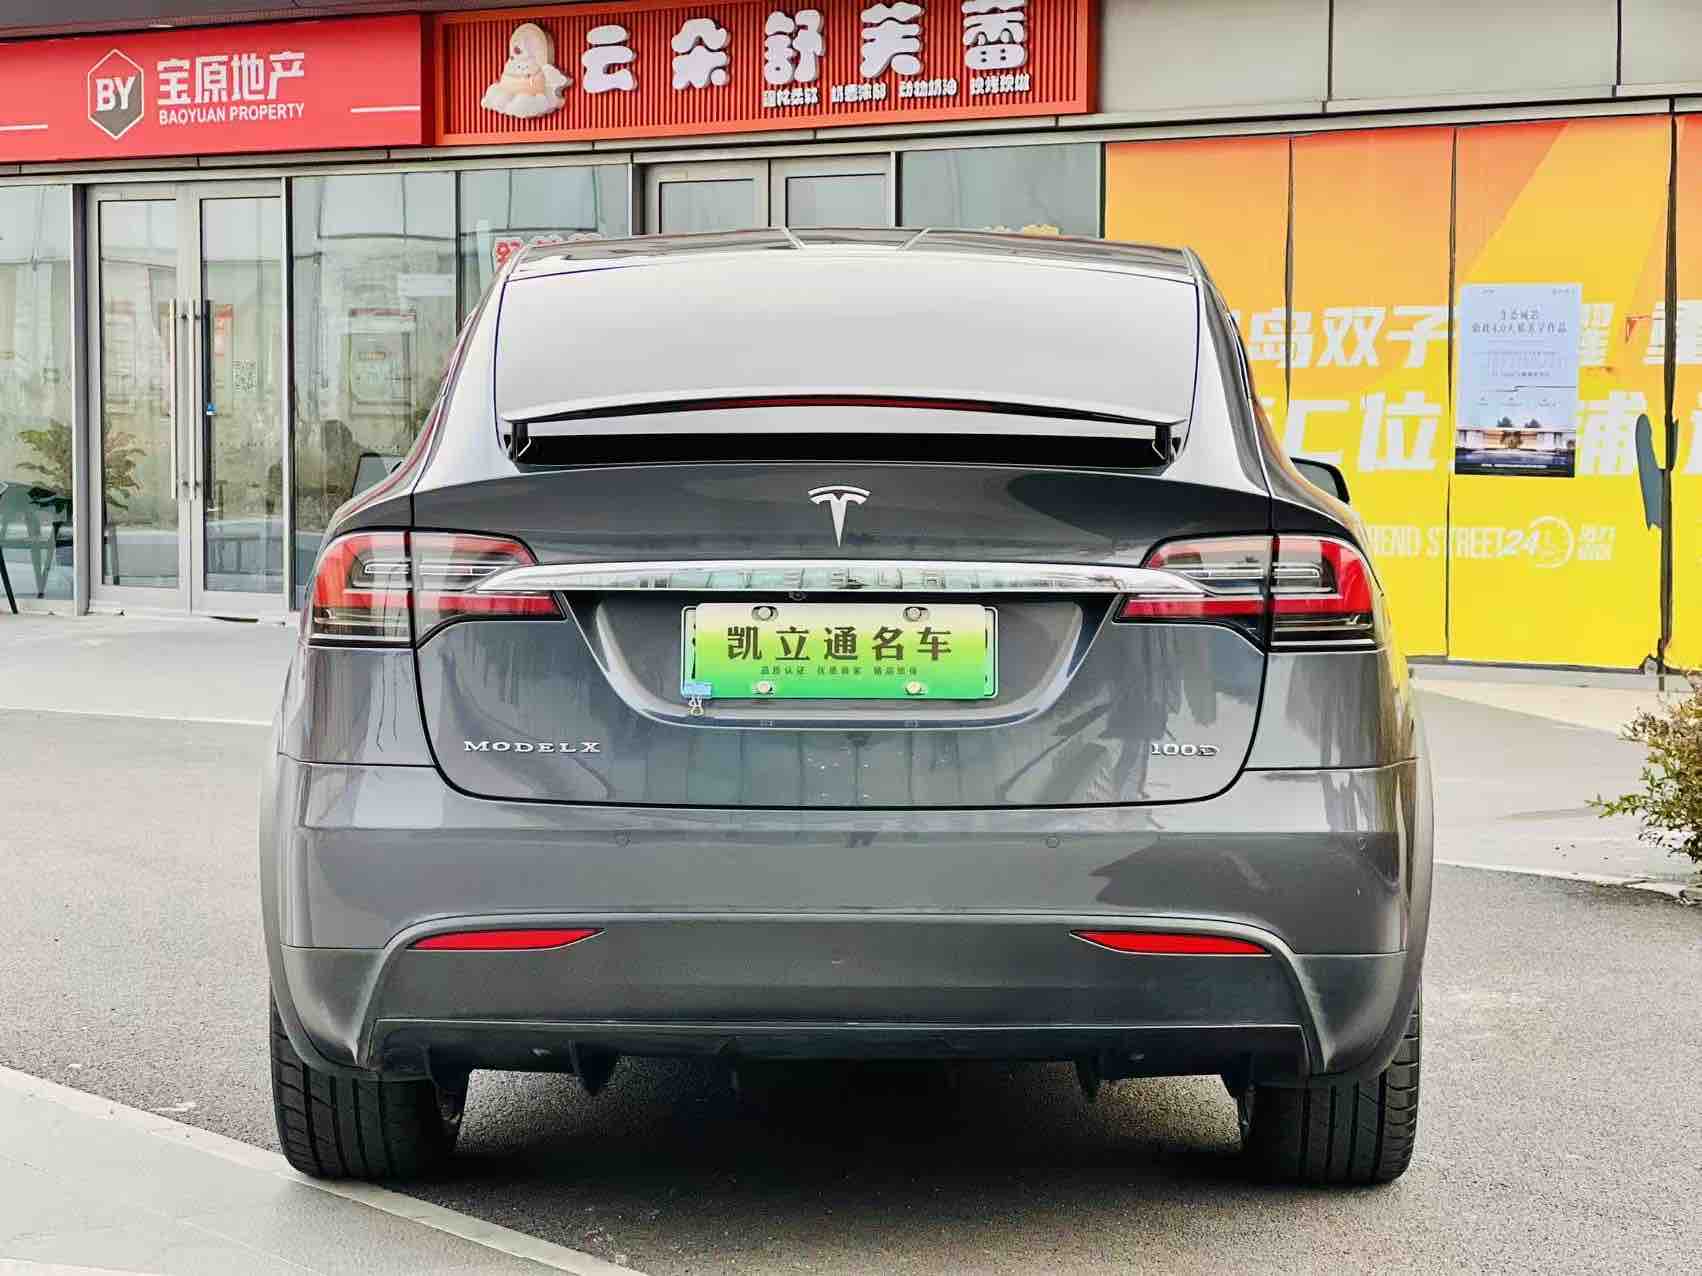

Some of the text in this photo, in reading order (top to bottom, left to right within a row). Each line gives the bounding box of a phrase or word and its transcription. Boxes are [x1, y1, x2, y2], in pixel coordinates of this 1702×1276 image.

[582, 0, 1027, 93] 云朵舒芙蕾
[95, 76, 136, 112] BY
[157, 51, 305, 105] 宝原地产
[159, 102, 305, 126] BAOYUAN PROPERTY
[727, 626, 952, 661] 凯立通名车
